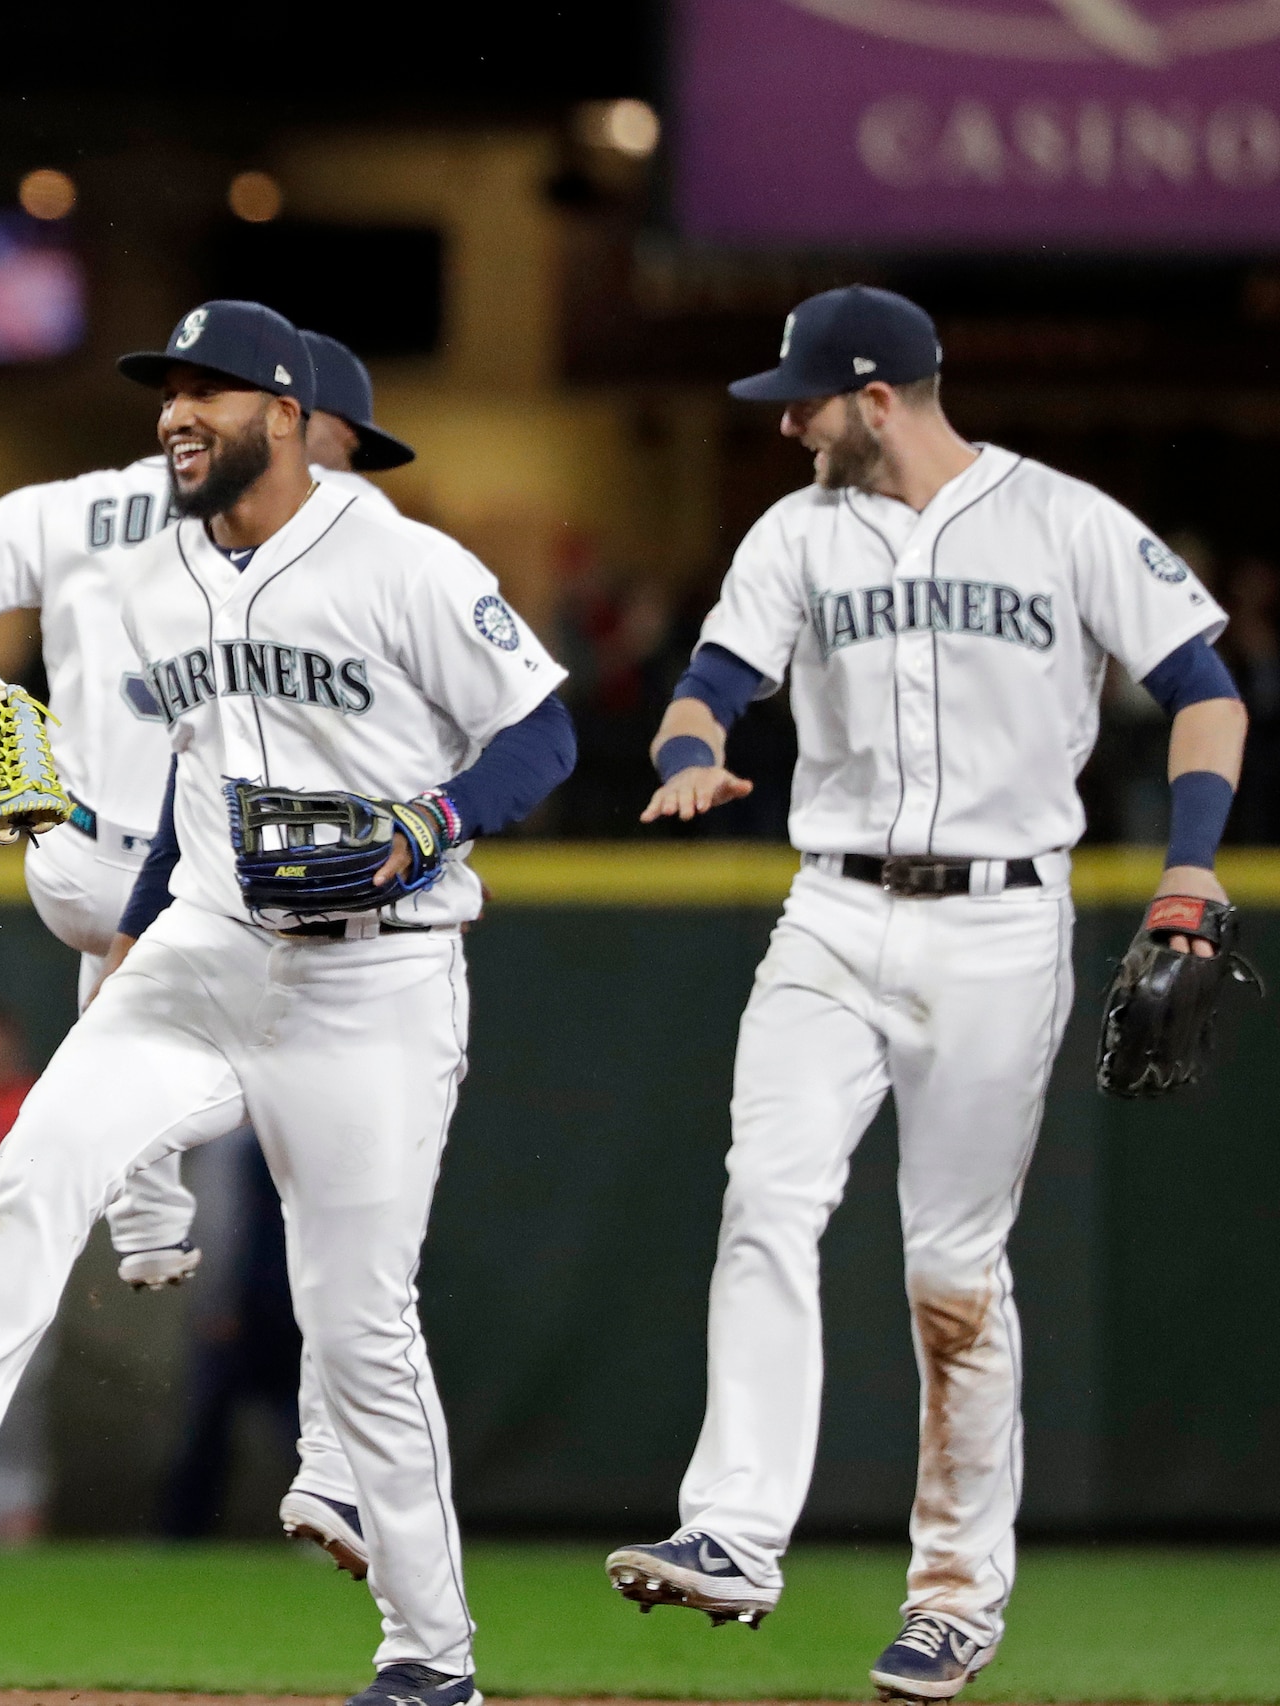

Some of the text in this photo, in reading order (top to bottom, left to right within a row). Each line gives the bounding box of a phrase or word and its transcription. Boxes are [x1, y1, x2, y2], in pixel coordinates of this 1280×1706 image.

[857, 97, 1280, 188] CASINO
[175, 308, 210, 350] S
[274, 865, 308, 878] A2K
